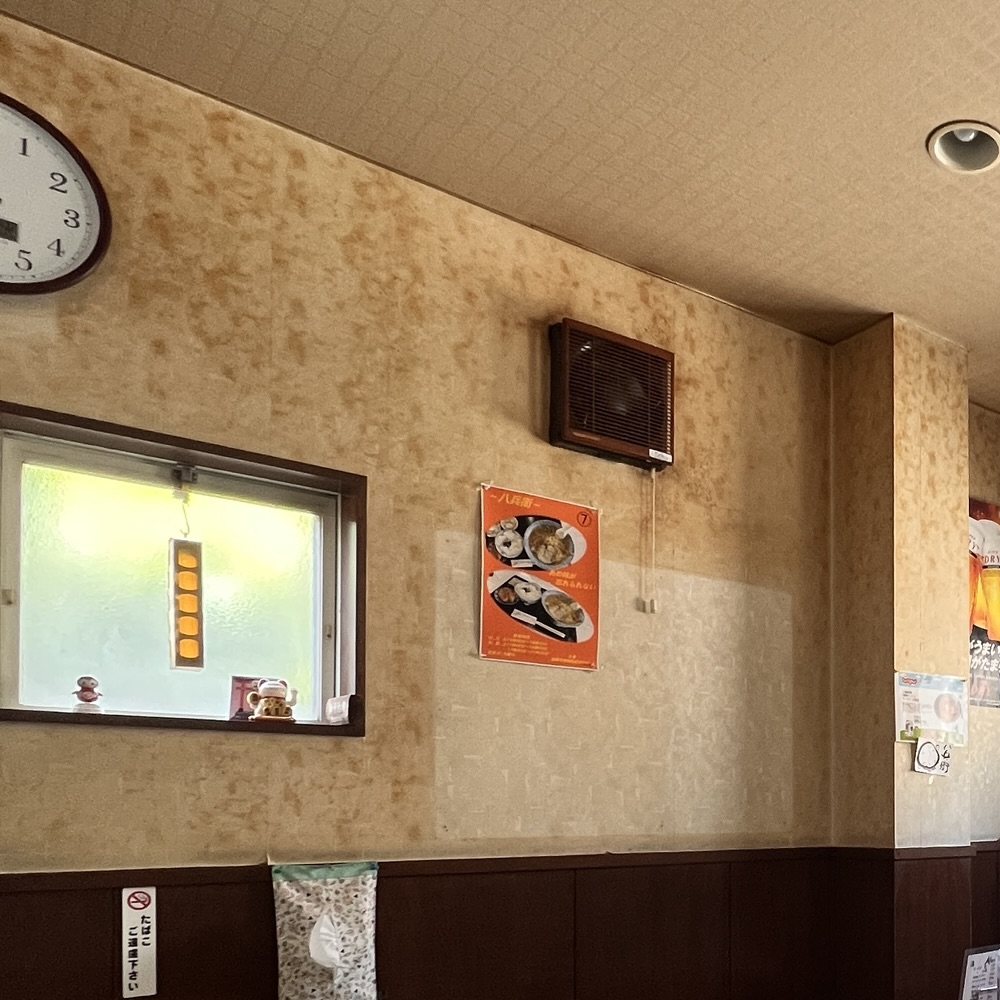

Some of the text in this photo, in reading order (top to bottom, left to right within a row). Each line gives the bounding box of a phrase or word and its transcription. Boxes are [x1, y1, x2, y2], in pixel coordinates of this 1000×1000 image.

[19, 138, 29, 157] 1
[49, 172, 68, 194] 2
[64, 209, 80, 229] 3
[47, 238, 64, 258] 4
[14, 249, 33, 272] 5
[141, 914, 151, 947] たばこ
